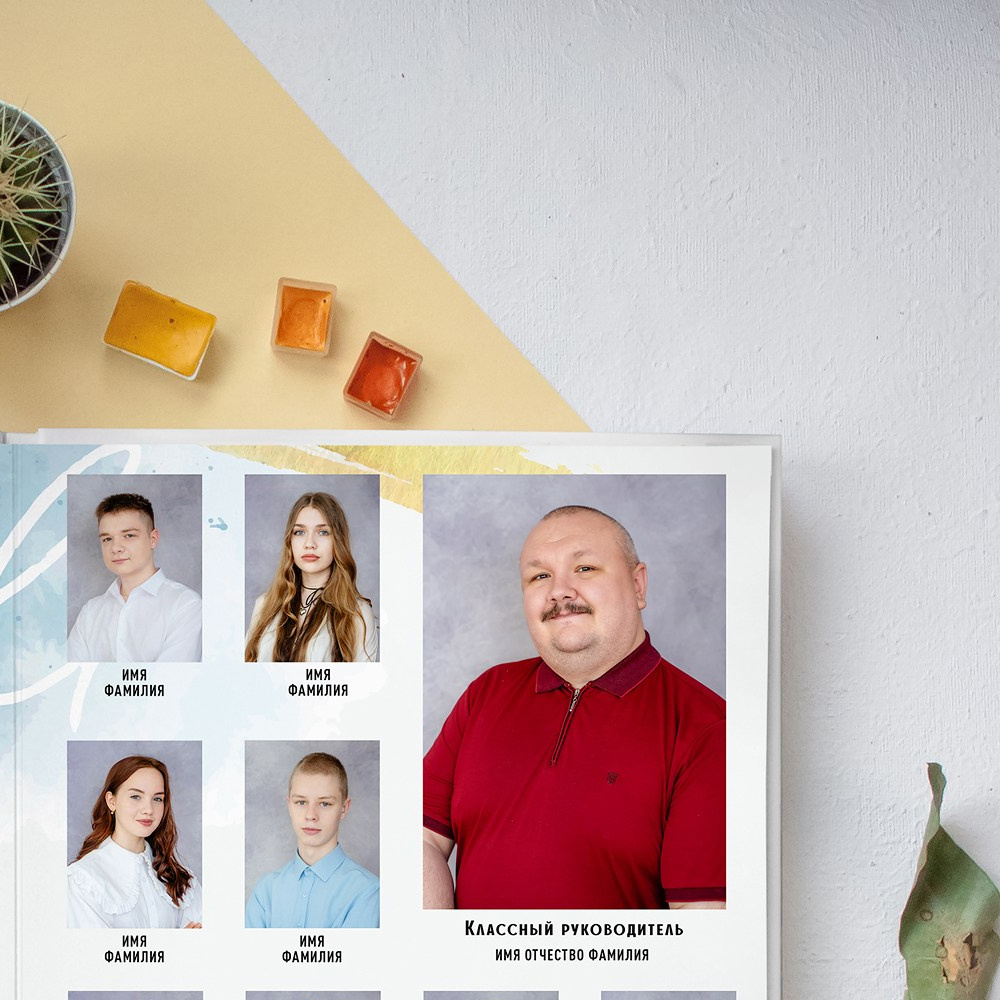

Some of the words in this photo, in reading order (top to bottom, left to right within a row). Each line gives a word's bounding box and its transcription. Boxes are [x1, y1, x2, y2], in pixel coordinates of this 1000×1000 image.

[122, 668, 147, 681] ИМЯ
[306, 668, 331, 681] ИМЯ
[104, 683, 165, 697] ФАМИЛИЯ
[288, 683, 348, 697] ФАМИЛИЯ
[122, 935, 147, 948] ИМЯ
[299, 935, 325, 948] ИМЯ
[104, 950, 165, 963] ФАМИЛИЯ
[282, 950, 342, 963] ФАМИЛИЯ
[495, 948, 520, 961] ИМЯ
[524, 948, 584, 961] ОТЧЕСТВО
[588, 948, 649, 961] ФАМИЛИЯ
